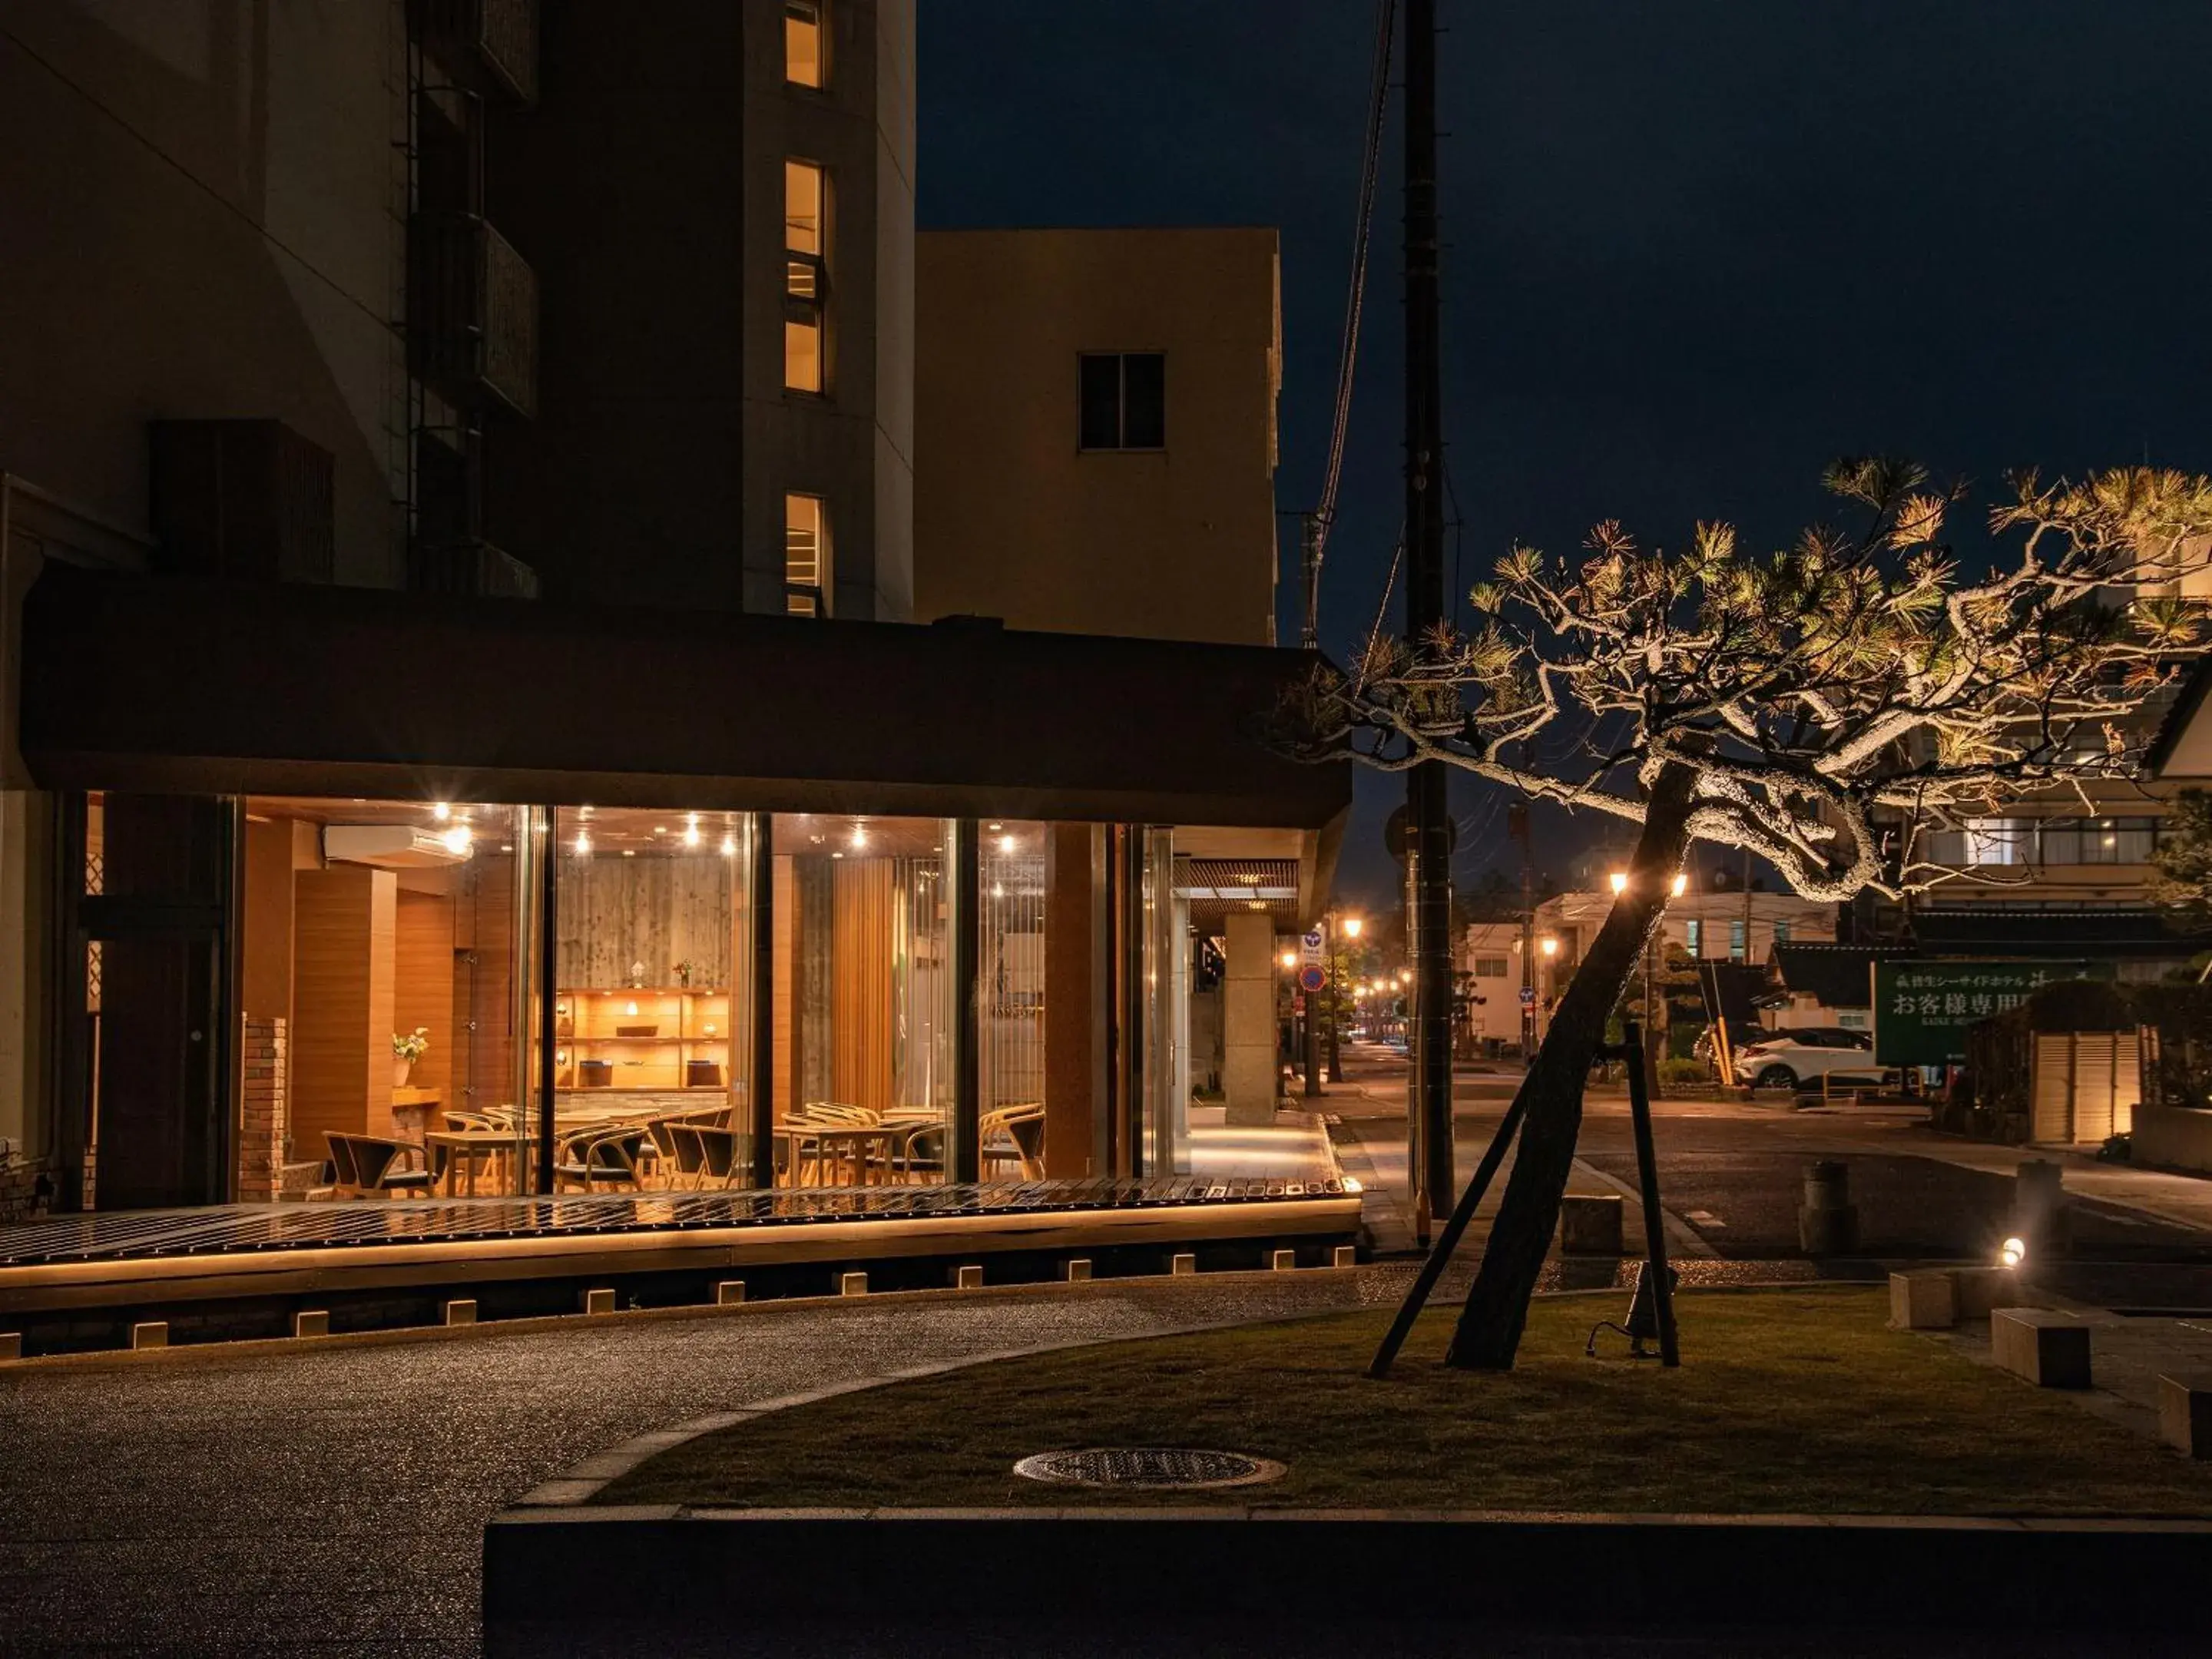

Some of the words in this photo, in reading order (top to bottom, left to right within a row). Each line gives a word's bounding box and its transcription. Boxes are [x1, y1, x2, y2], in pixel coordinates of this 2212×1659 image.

[1892, 993, 2033, 1015] お客様専用
